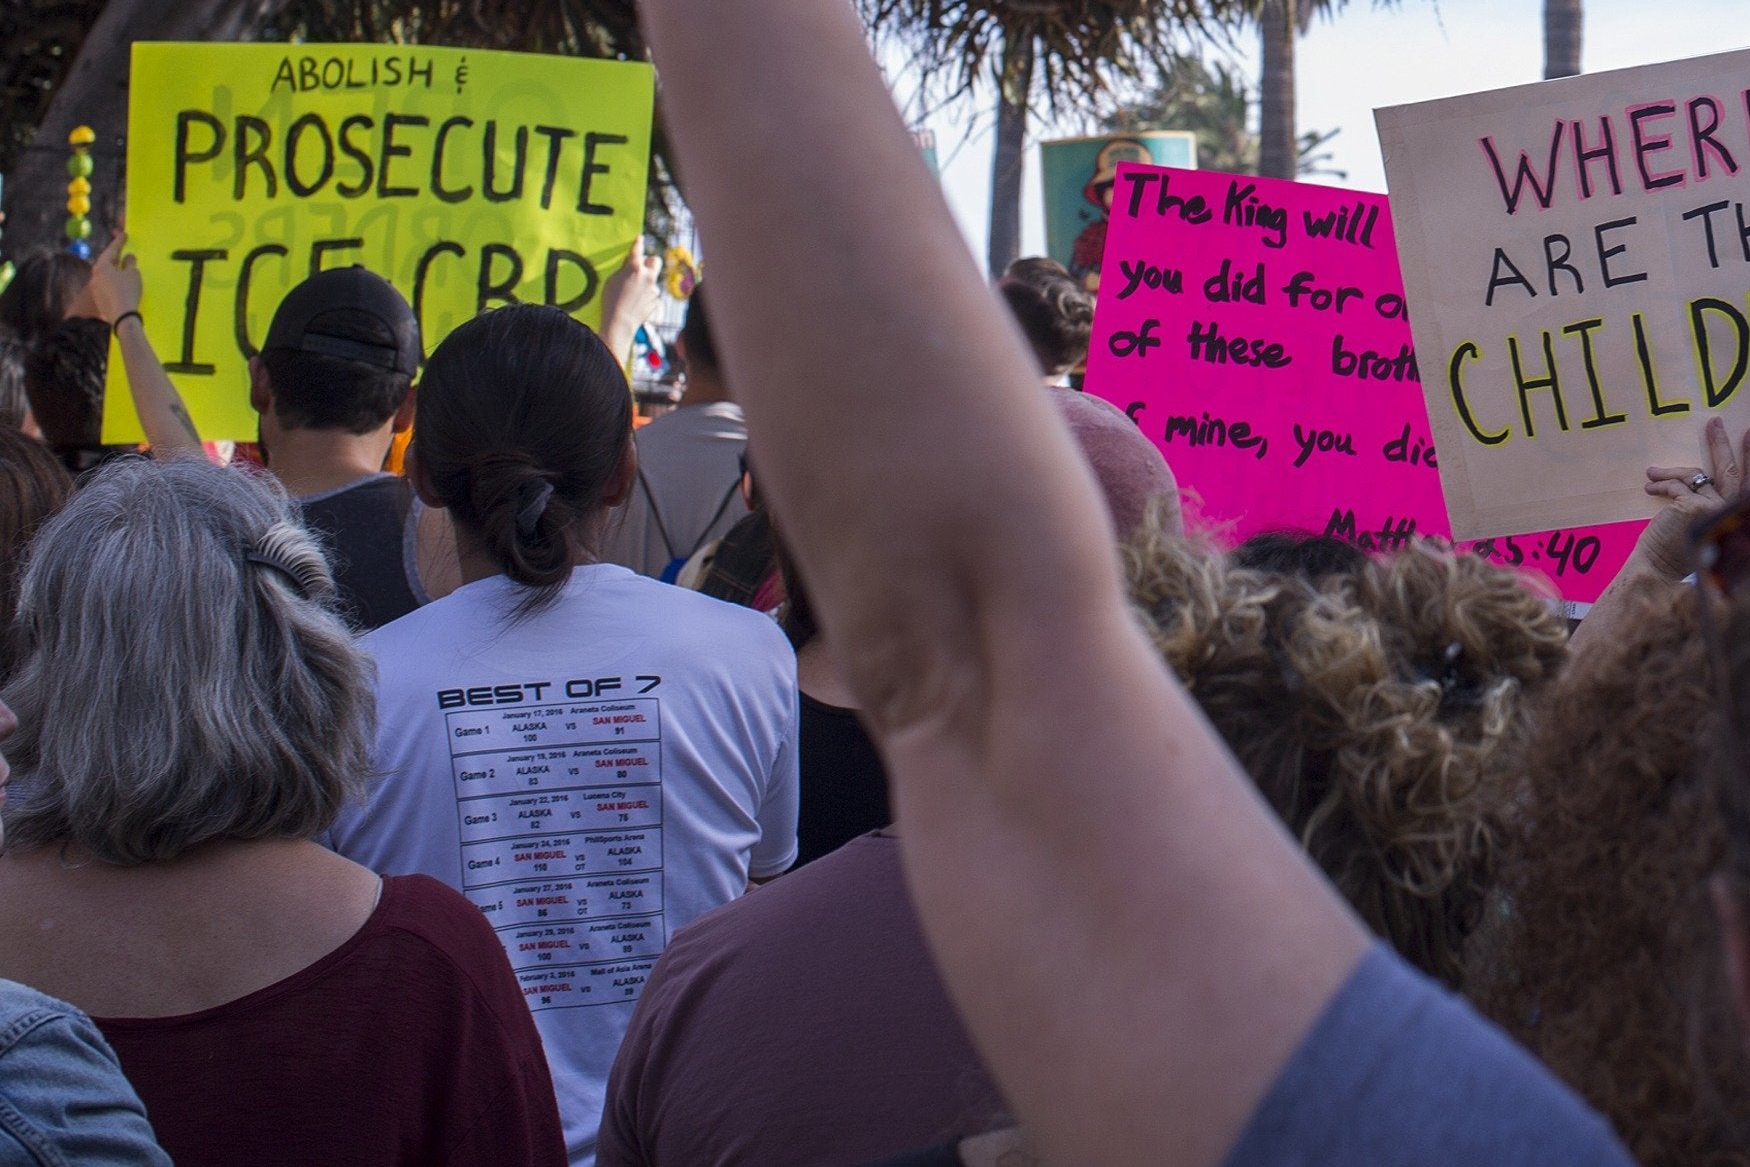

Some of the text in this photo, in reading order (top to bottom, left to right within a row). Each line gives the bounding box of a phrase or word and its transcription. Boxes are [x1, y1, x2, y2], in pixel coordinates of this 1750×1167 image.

[270, 55, 434, 94] ABOLISH
[172, 109, 630, 218] PROSECUTE
[1123, 171, 1380, 250] The King will
[1485, 216, 1648, 307] ARE
[1116, 259, 1184, 300] you
[1202, 259, 1267, 305] did
[1281, 272, 1366, 314] for
[1108, 319, 1161, 357] of
[1186, 321, 1293, 369] these
[1164, 411, 1268, 460] mine,
[1293, 423, 1357, 468] you
[437, 675, 661, 709] BEST OF 7
[455, 726, 483, 738] Game
[512, 714, 646, 732] ALASKA VS SAN MIGUEL
[460, 769, 495, 782] Game 2
[516, 757, 648, 776] ALASKA VS SAN MIGUEL
[518, 800, 650, 819] ALASKA VS SAN MIGUEL
[464, 813, 498, 826] Game 3
[514, 852, 532, 862] SAN
[534, 850, 567, 860] MIGUEL
[607, 846, 642, 857] ALASKA
[468, 857, 500, 870] Game 4
[516, 898, 535, 907] SAN
[537, 896, 569, 906] MIGUEL
[608, 890, 643, 900] ALASKA
[476, 903, 497, 913] ame
[519, 942, 537, 951] SAN
[539, 940, 571, 949] MIGUEL
[611, 933, 645, 943] ALASKA
[540, 983, 572, 993] MIGUEL
[613, 976, 645, 986] ALASKA
